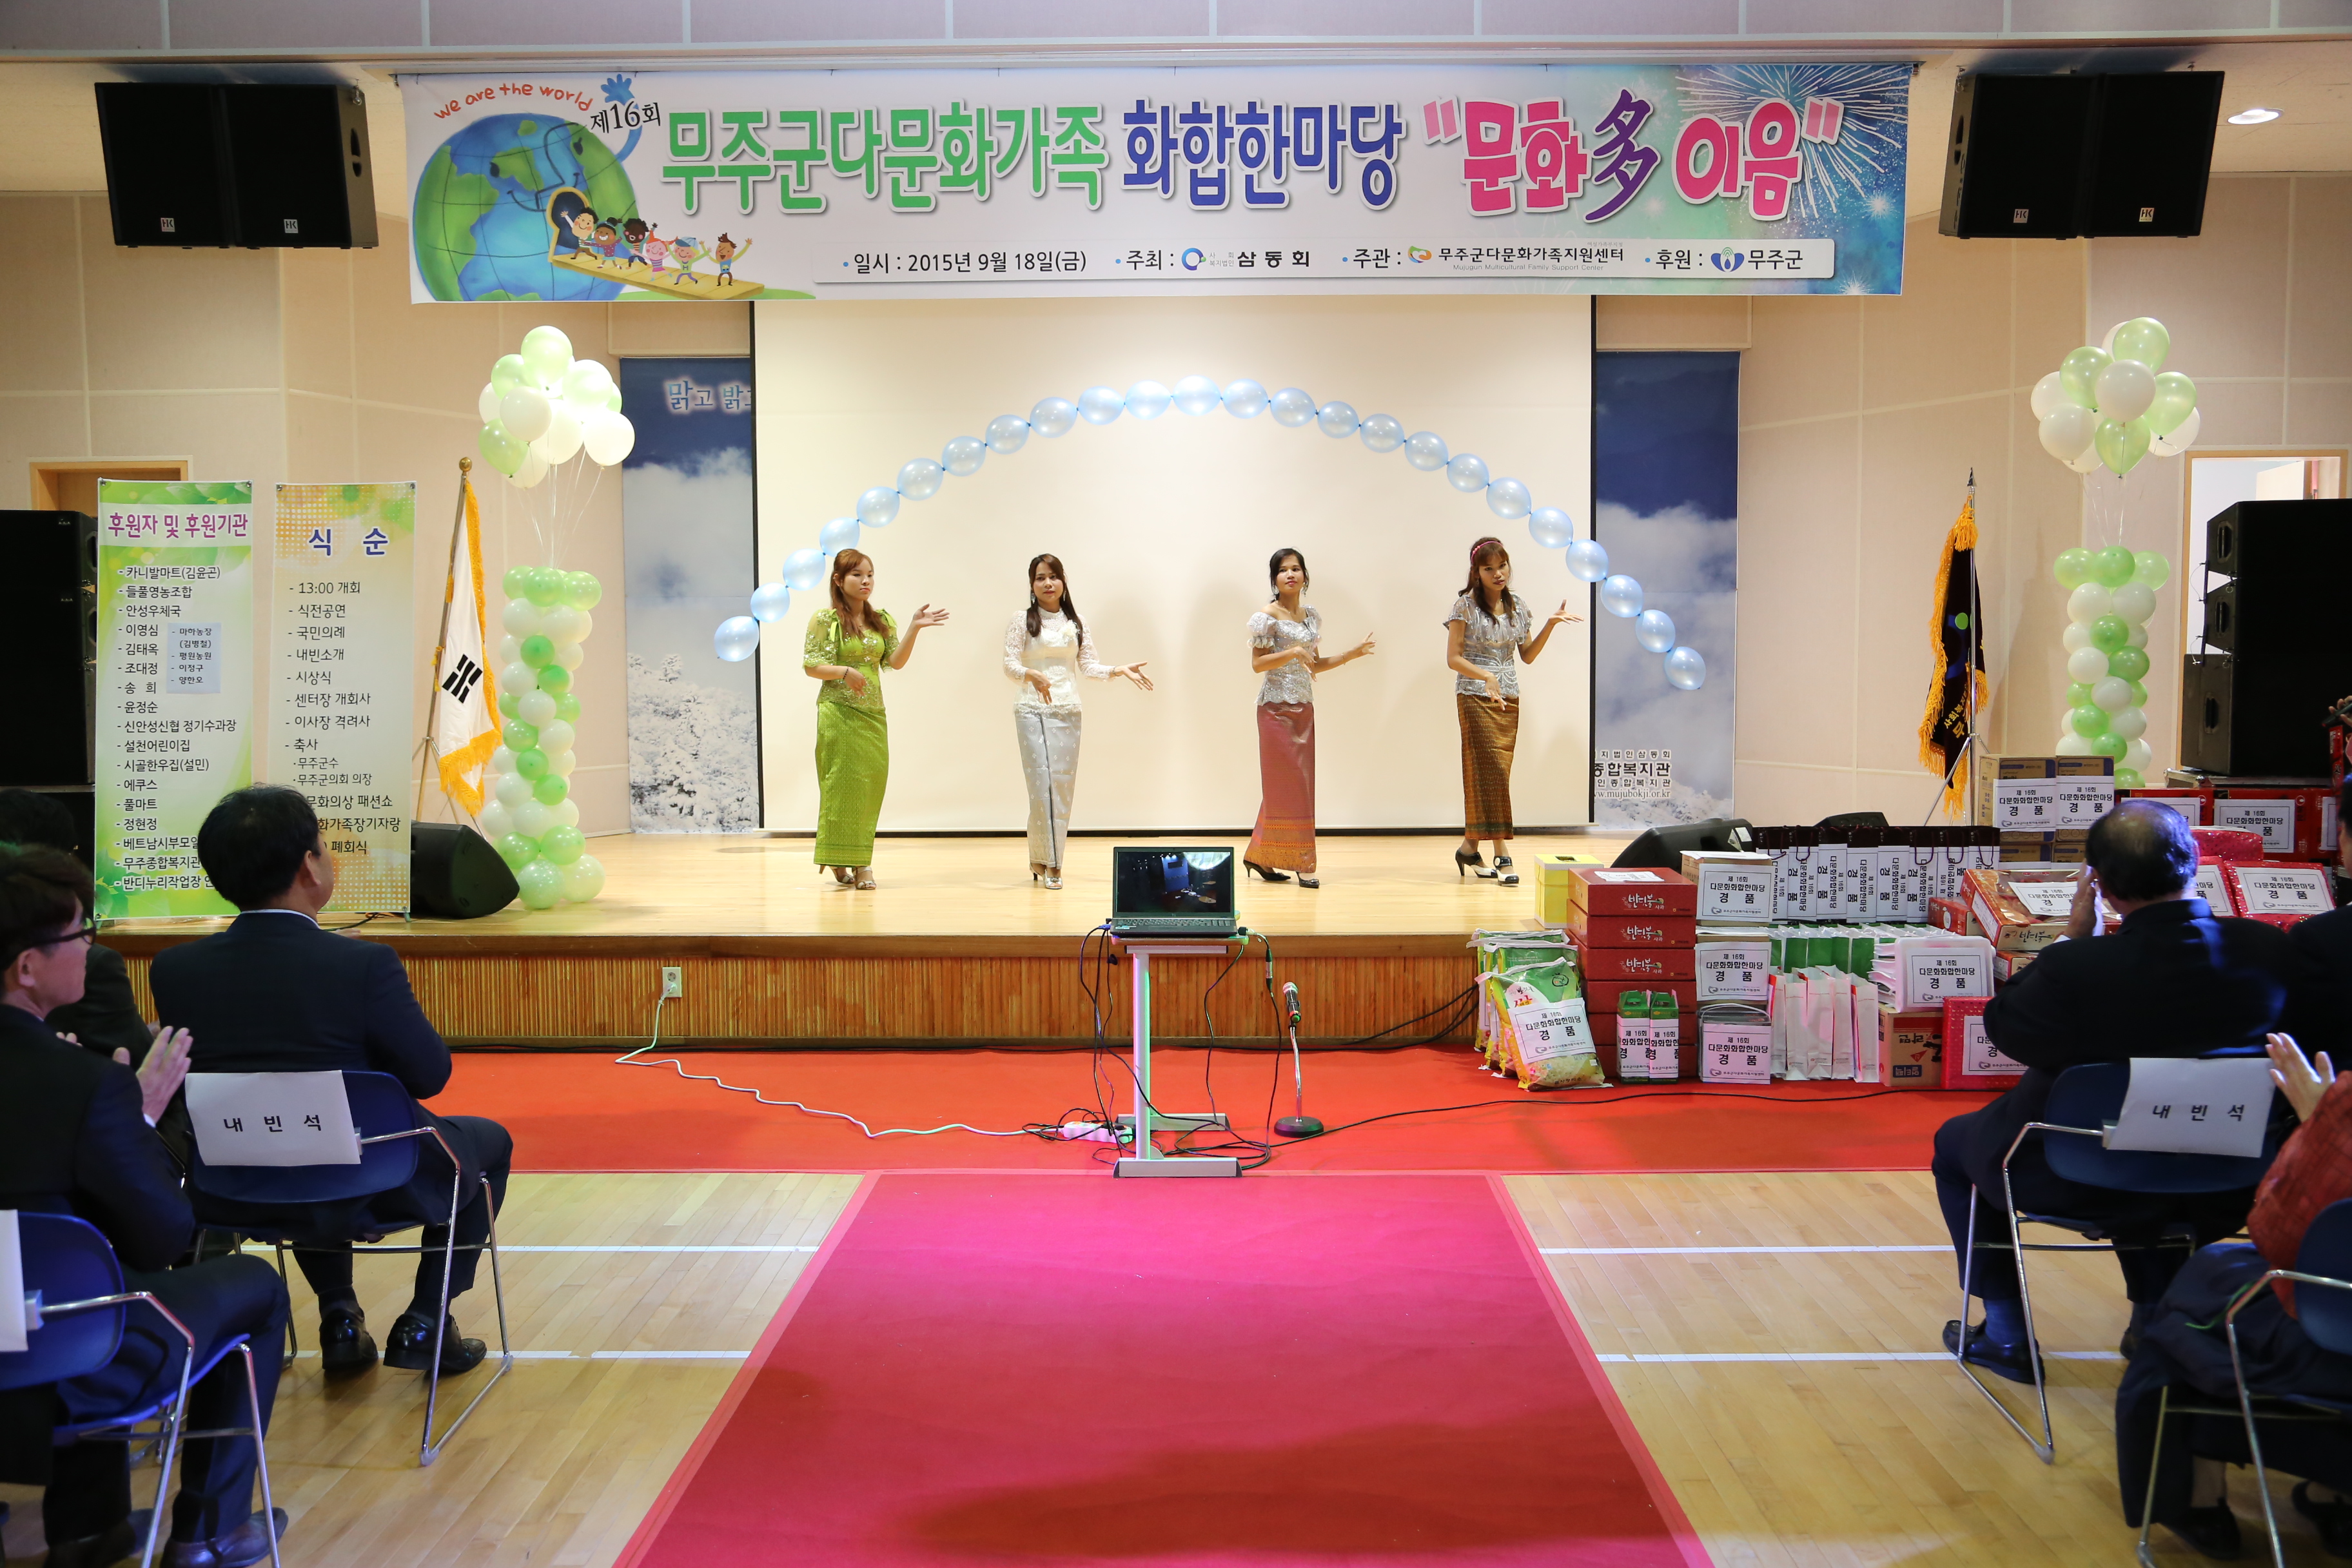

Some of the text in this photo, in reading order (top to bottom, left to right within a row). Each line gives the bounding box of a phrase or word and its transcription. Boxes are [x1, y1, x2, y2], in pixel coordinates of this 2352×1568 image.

[434, 82, 594, 120] we are the world
[590, 102, 662, 134] 제16회
[662, 101, 1106, 211] 무주군다문화가족
[1122, 99, 1403, 207] 화합한마당
[854, 251, 1086, 273] 일시 2015년 9월 18일(금)
[1126, 250, 1162, 270] 주최
[1354, 247, 1623, 268] 주관 무주군다문화가족지원센터
[1656, 250, 1803, 270] 후원 무주군
[667, 380, 713, 410] 맑고
[108, 513, 248, 538] 후원자 및 후원기관
[309, 528, 388, 556] 식 순
[299, 582, 360, 594] 13:00 개회
[126, 605, 181, 617] 안성우체국
[298, 604, 346, 619] 식전공연
[126, 624, 158, 636] 이영심
[297, 627, 345, 640] 국민의례
[126, 643, 159, 656] 김태옥
[297, 649, 344, 662] 내빈소개
[125, 663, 158, 674] 조대정
[296, 671, 331, 685] 시상식
[295, 692, 371, 707] 센터장 개회사
[124, 701, 158, 714] 윤정순
[124, 720, 237, 733] 신안성신협 정기수과장
[295, 715, 370, 730] 이사장 격려사
[124, 740, 190, 752] 설천어린이집
[293, 738, 318, 752] 축사
[1594, 750, 1671, 759] 지법인삼동회
[124, 759, 209, 772] 시골한우집(설민)
[297, 758, 339, 769] 무주군수
[124, 779, 157, 792] 에쿠스
[297, 774, 373, 786] 무주군의회 의장
[124, 799, 157, 811] 풀마트
[358, 795, 393, 809] 패션쇼
[124, 818, 157, 830] 정현정
[331, 840, 367, 854] 폐회식
[124, 876, 201, 890] 반디누리작업장
[2153, 1104, 2244, 1121] 내 빈 석
[224, 1115, 322, 1132] 내 빈 석
